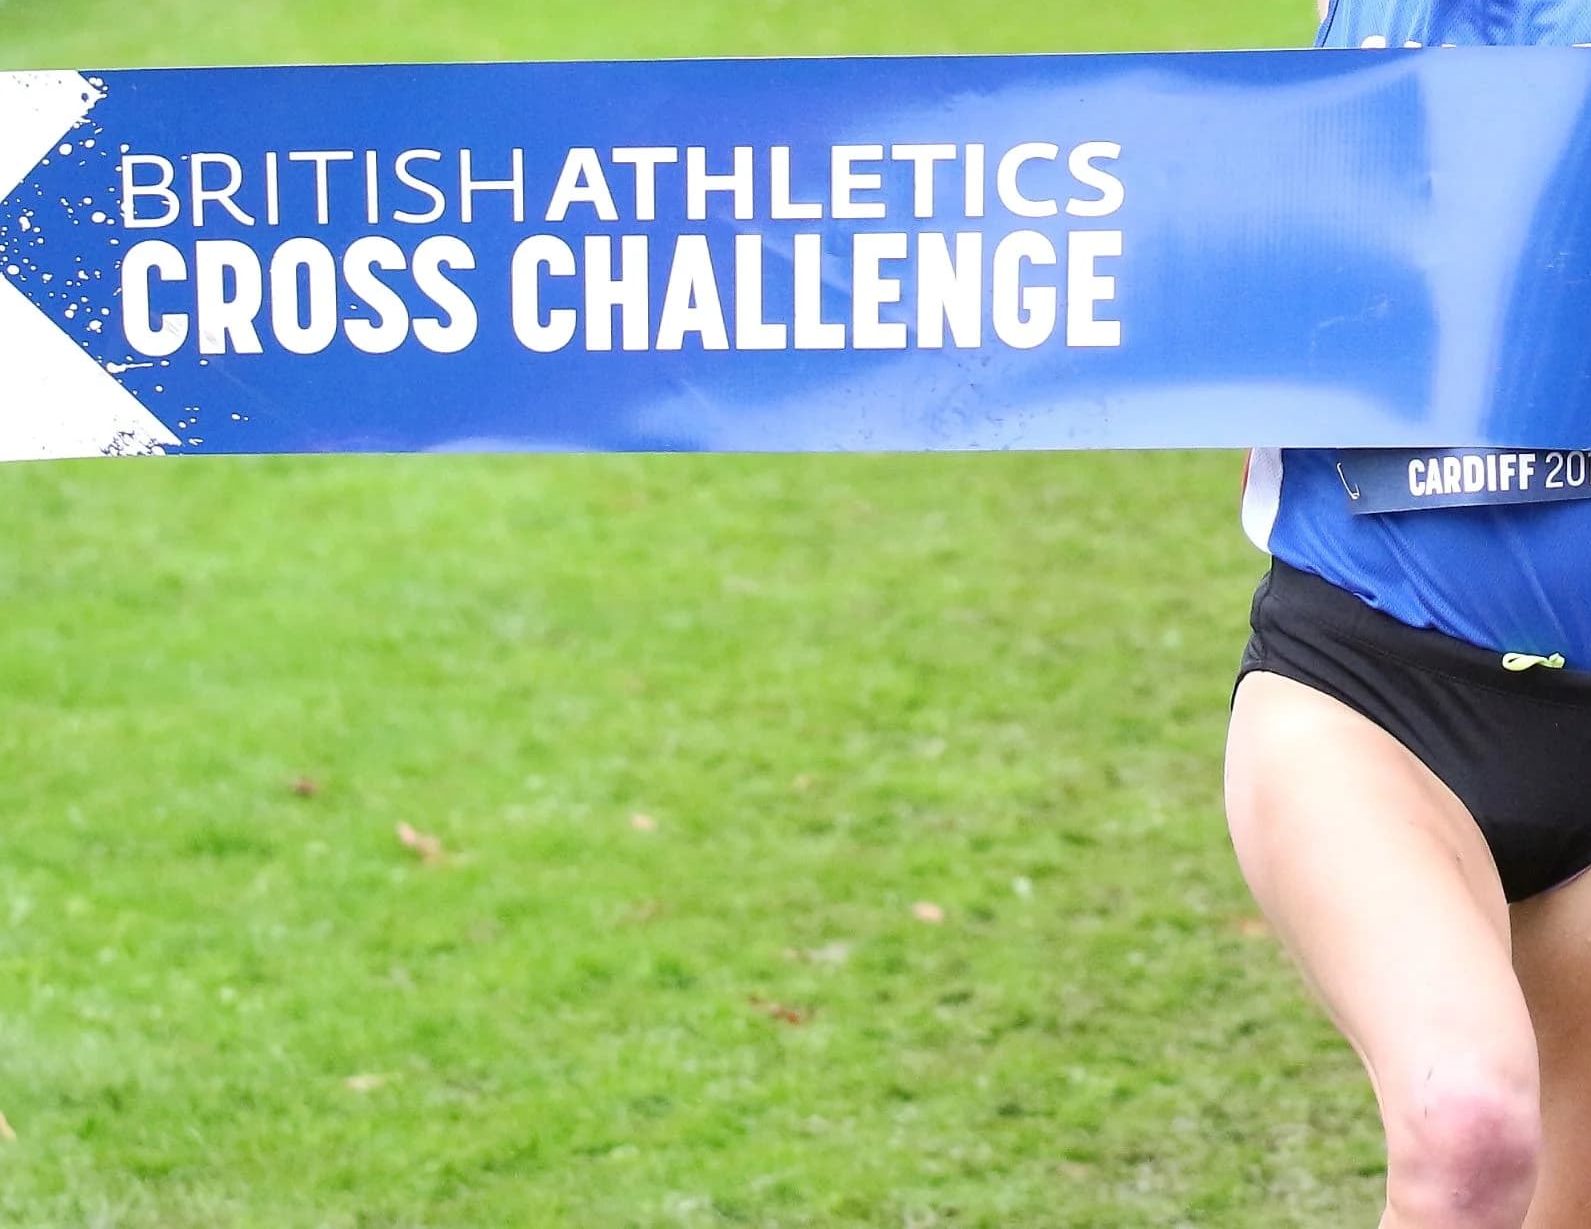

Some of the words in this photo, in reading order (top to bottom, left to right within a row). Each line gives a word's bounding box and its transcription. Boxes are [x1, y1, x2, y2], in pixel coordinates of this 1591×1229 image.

[119, 147, 526, 230] BRITISH
[544, 140, 1128, 222] ATHLETICS
[120, 234, 480, 358] CROSS
[510, 227, 1127, 354] CHALLENGE
[1407, 452, 1536, 498] CARDIFF
